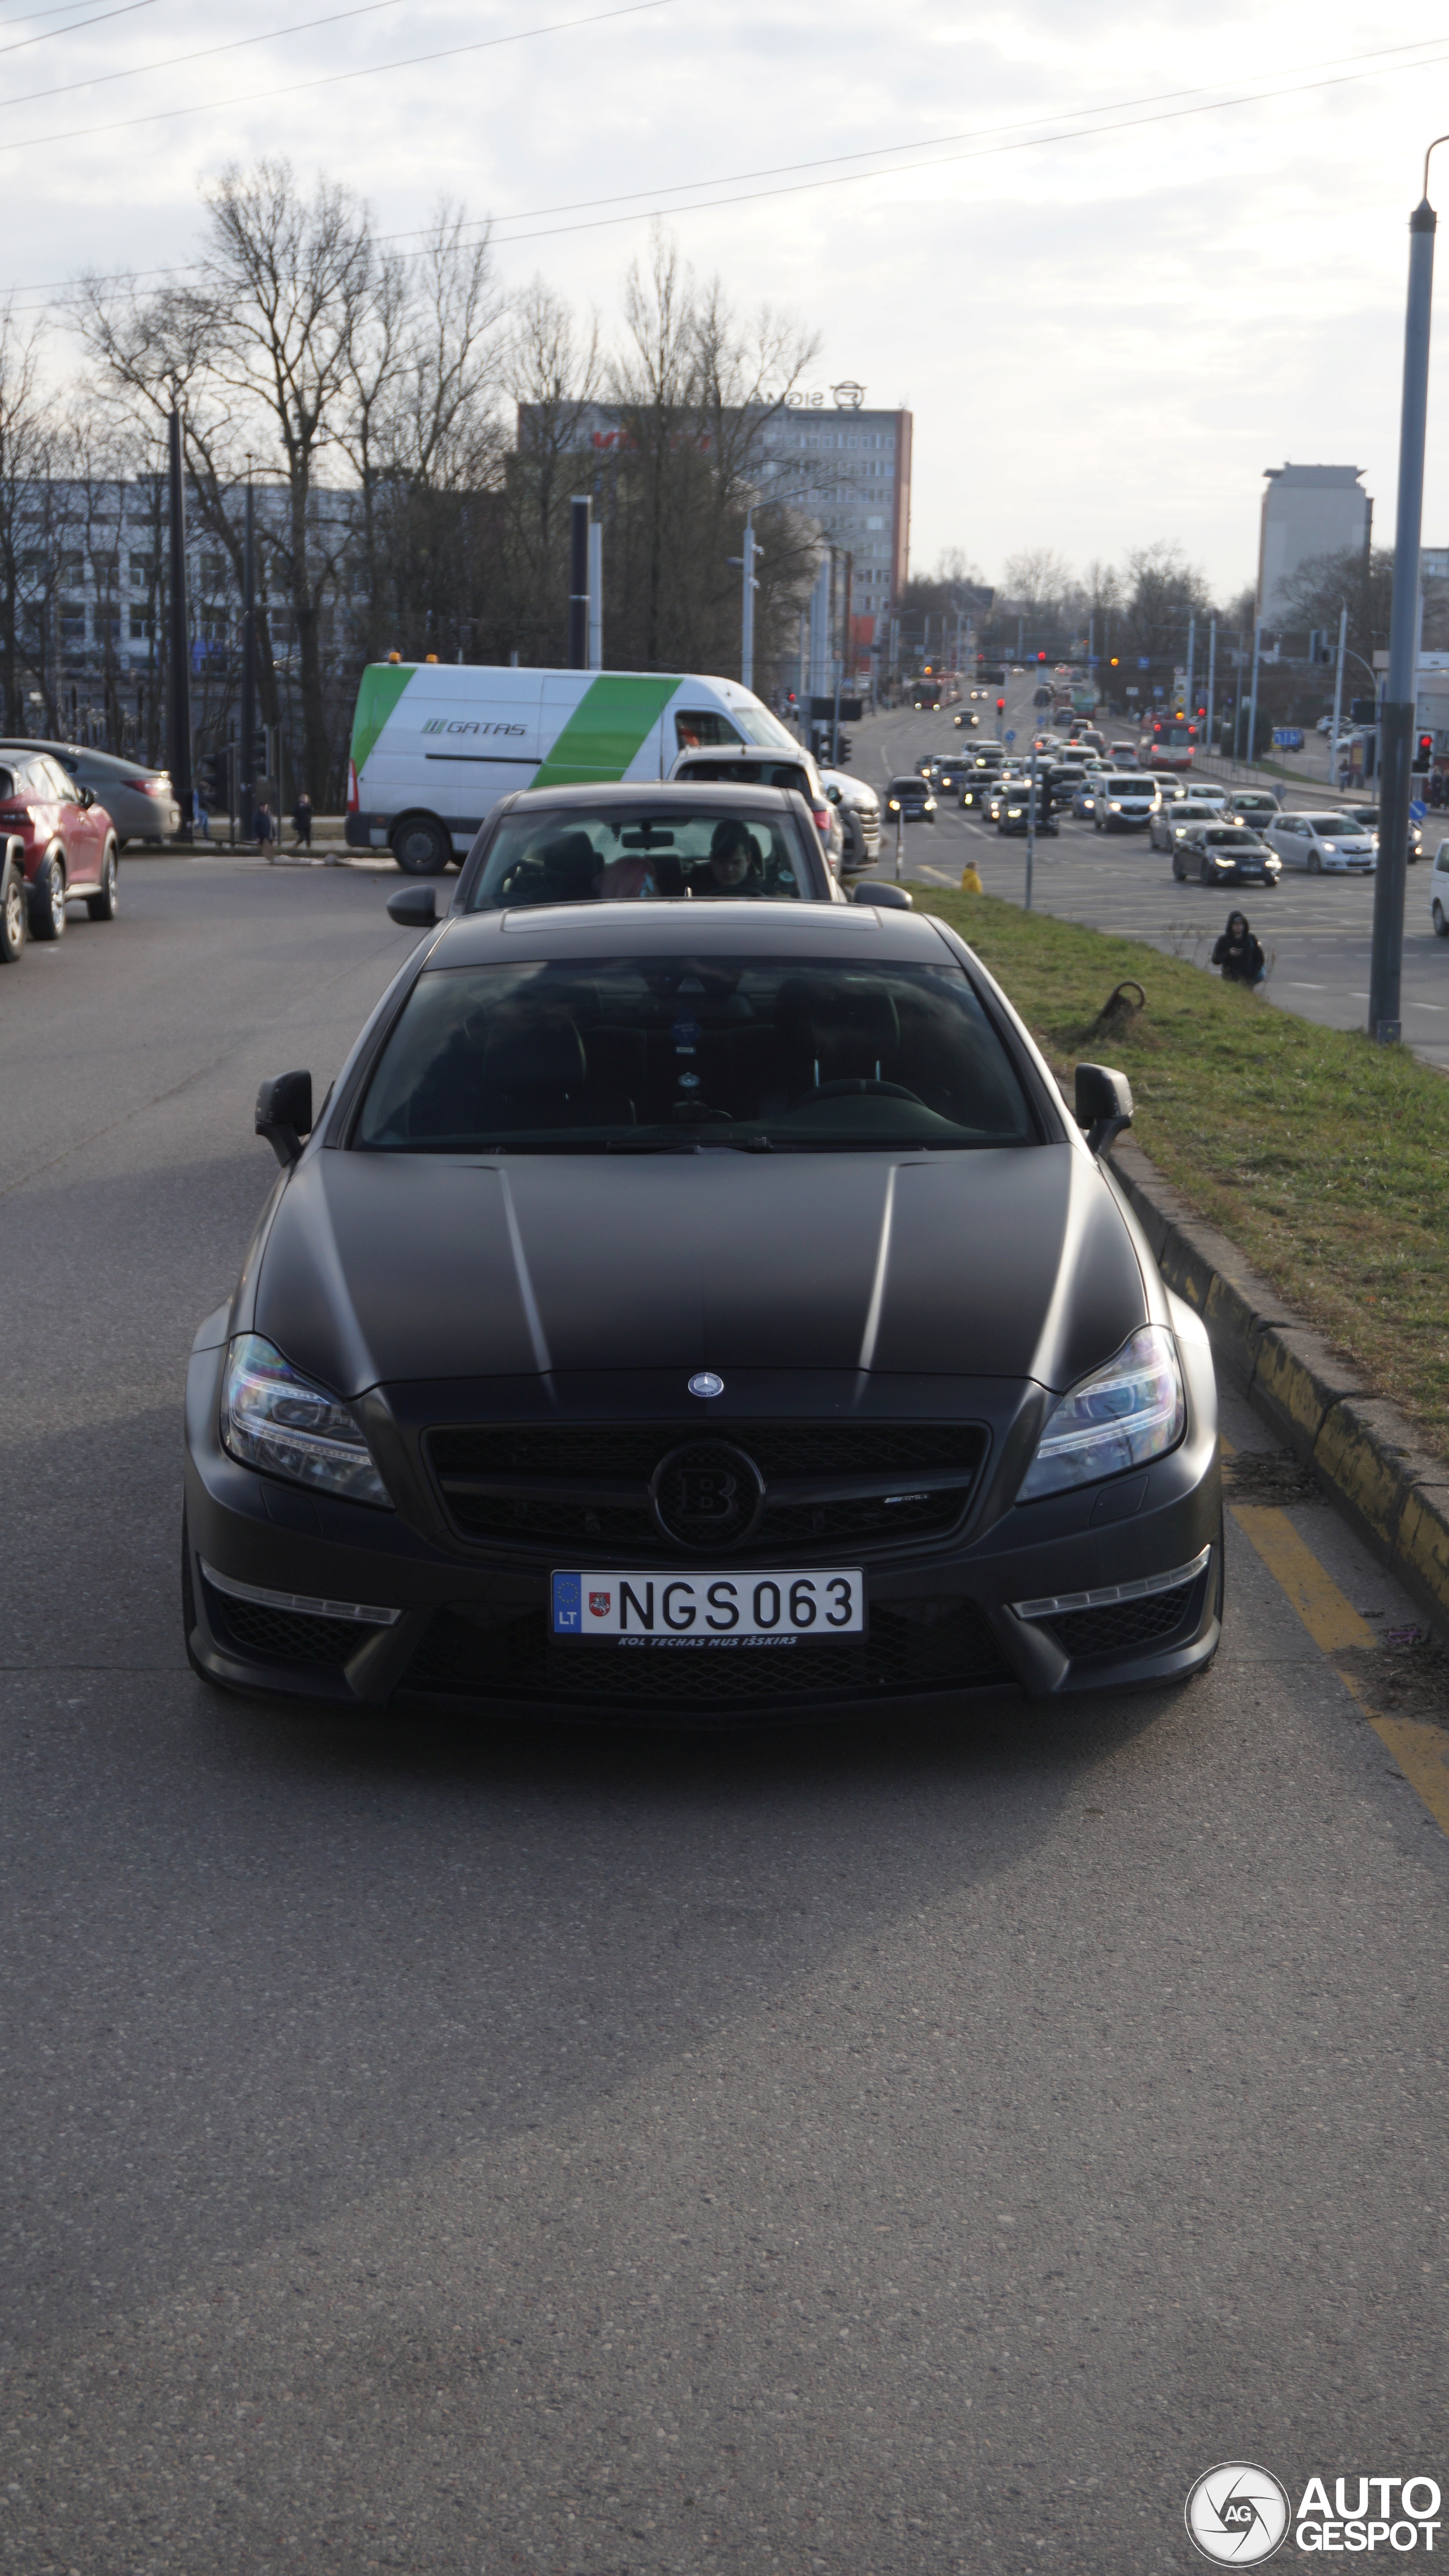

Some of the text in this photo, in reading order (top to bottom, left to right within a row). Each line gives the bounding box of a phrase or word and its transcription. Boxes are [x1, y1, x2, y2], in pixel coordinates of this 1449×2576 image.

[447, 721, 528, 735] GATAS
[559, 1611, 577, 1625] LT
[618, 1637, 645, 1646] KOL
[650, 1638, 705, 1646] TECHAS
[708, 1638, 739, 1646] MUS
